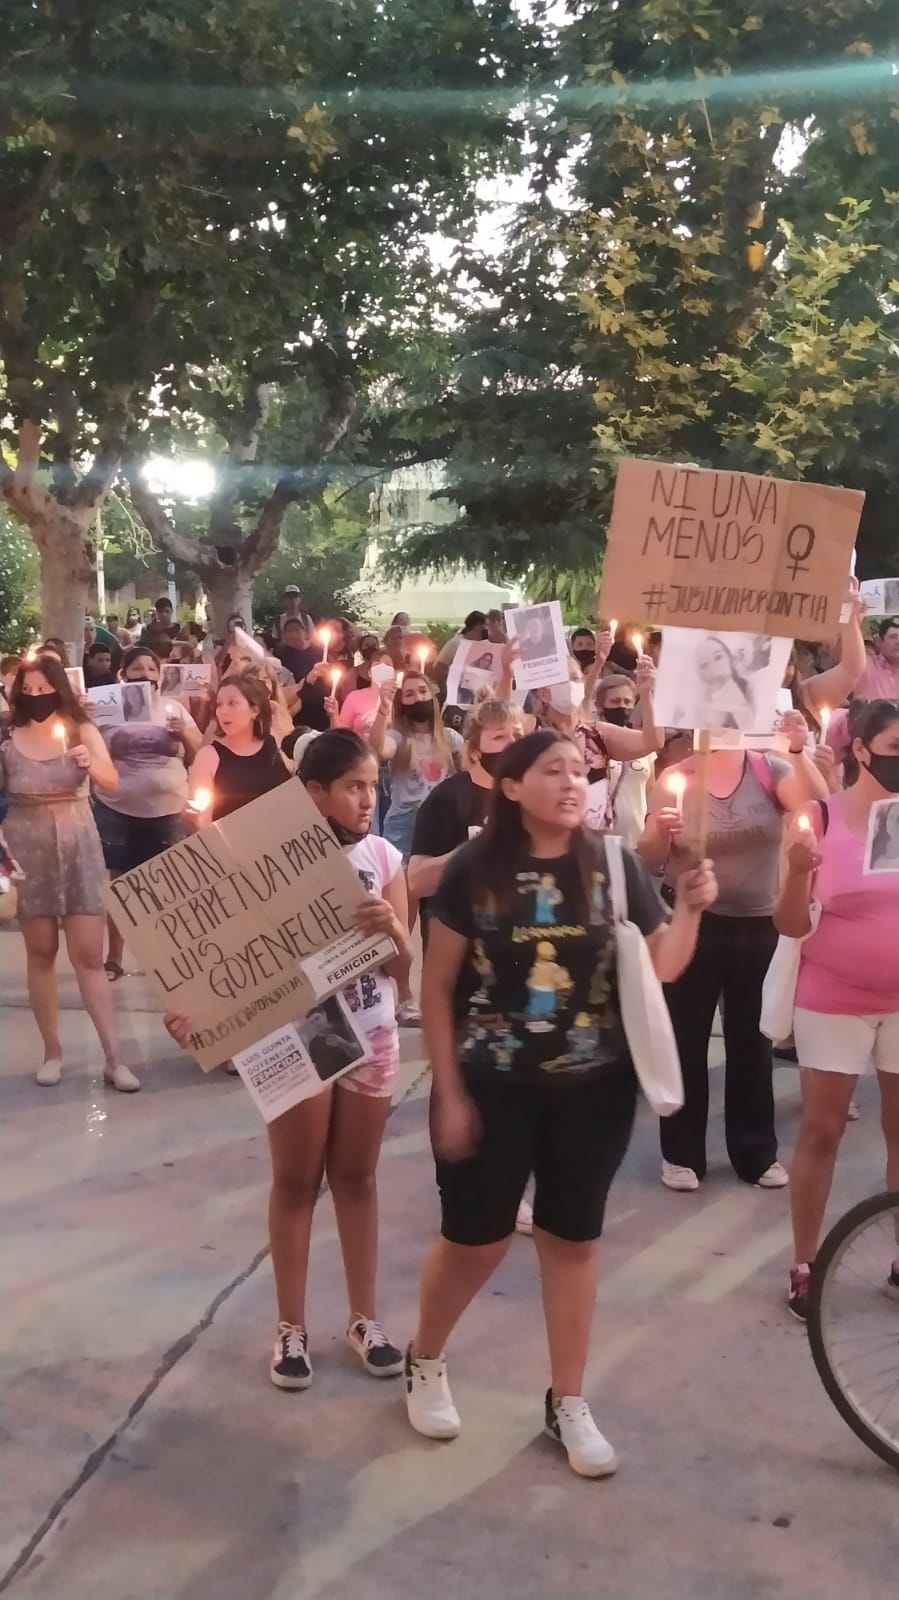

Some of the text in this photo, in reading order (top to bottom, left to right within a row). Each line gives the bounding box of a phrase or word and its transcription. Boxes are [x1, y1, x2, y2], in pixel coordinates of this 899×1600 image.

[651, 469, 777, 525] NI UNA
[641, 516, 764, 564] MENOS
[110, 833, 226, 927] PRISION
[155, 824, 341, 949] PERPETUA PARA
[154, 939, 224, 992] LUIS
[208, 887, 357, 999] GOYENECHE
[326, 949, 379, 984] FEMICIDA
[242, 1051, 261, 1066] LUIS
[247, 1043, 295, 1075] GOYENECHE
[252, 1051, 301, 1087] FEMICIDA
